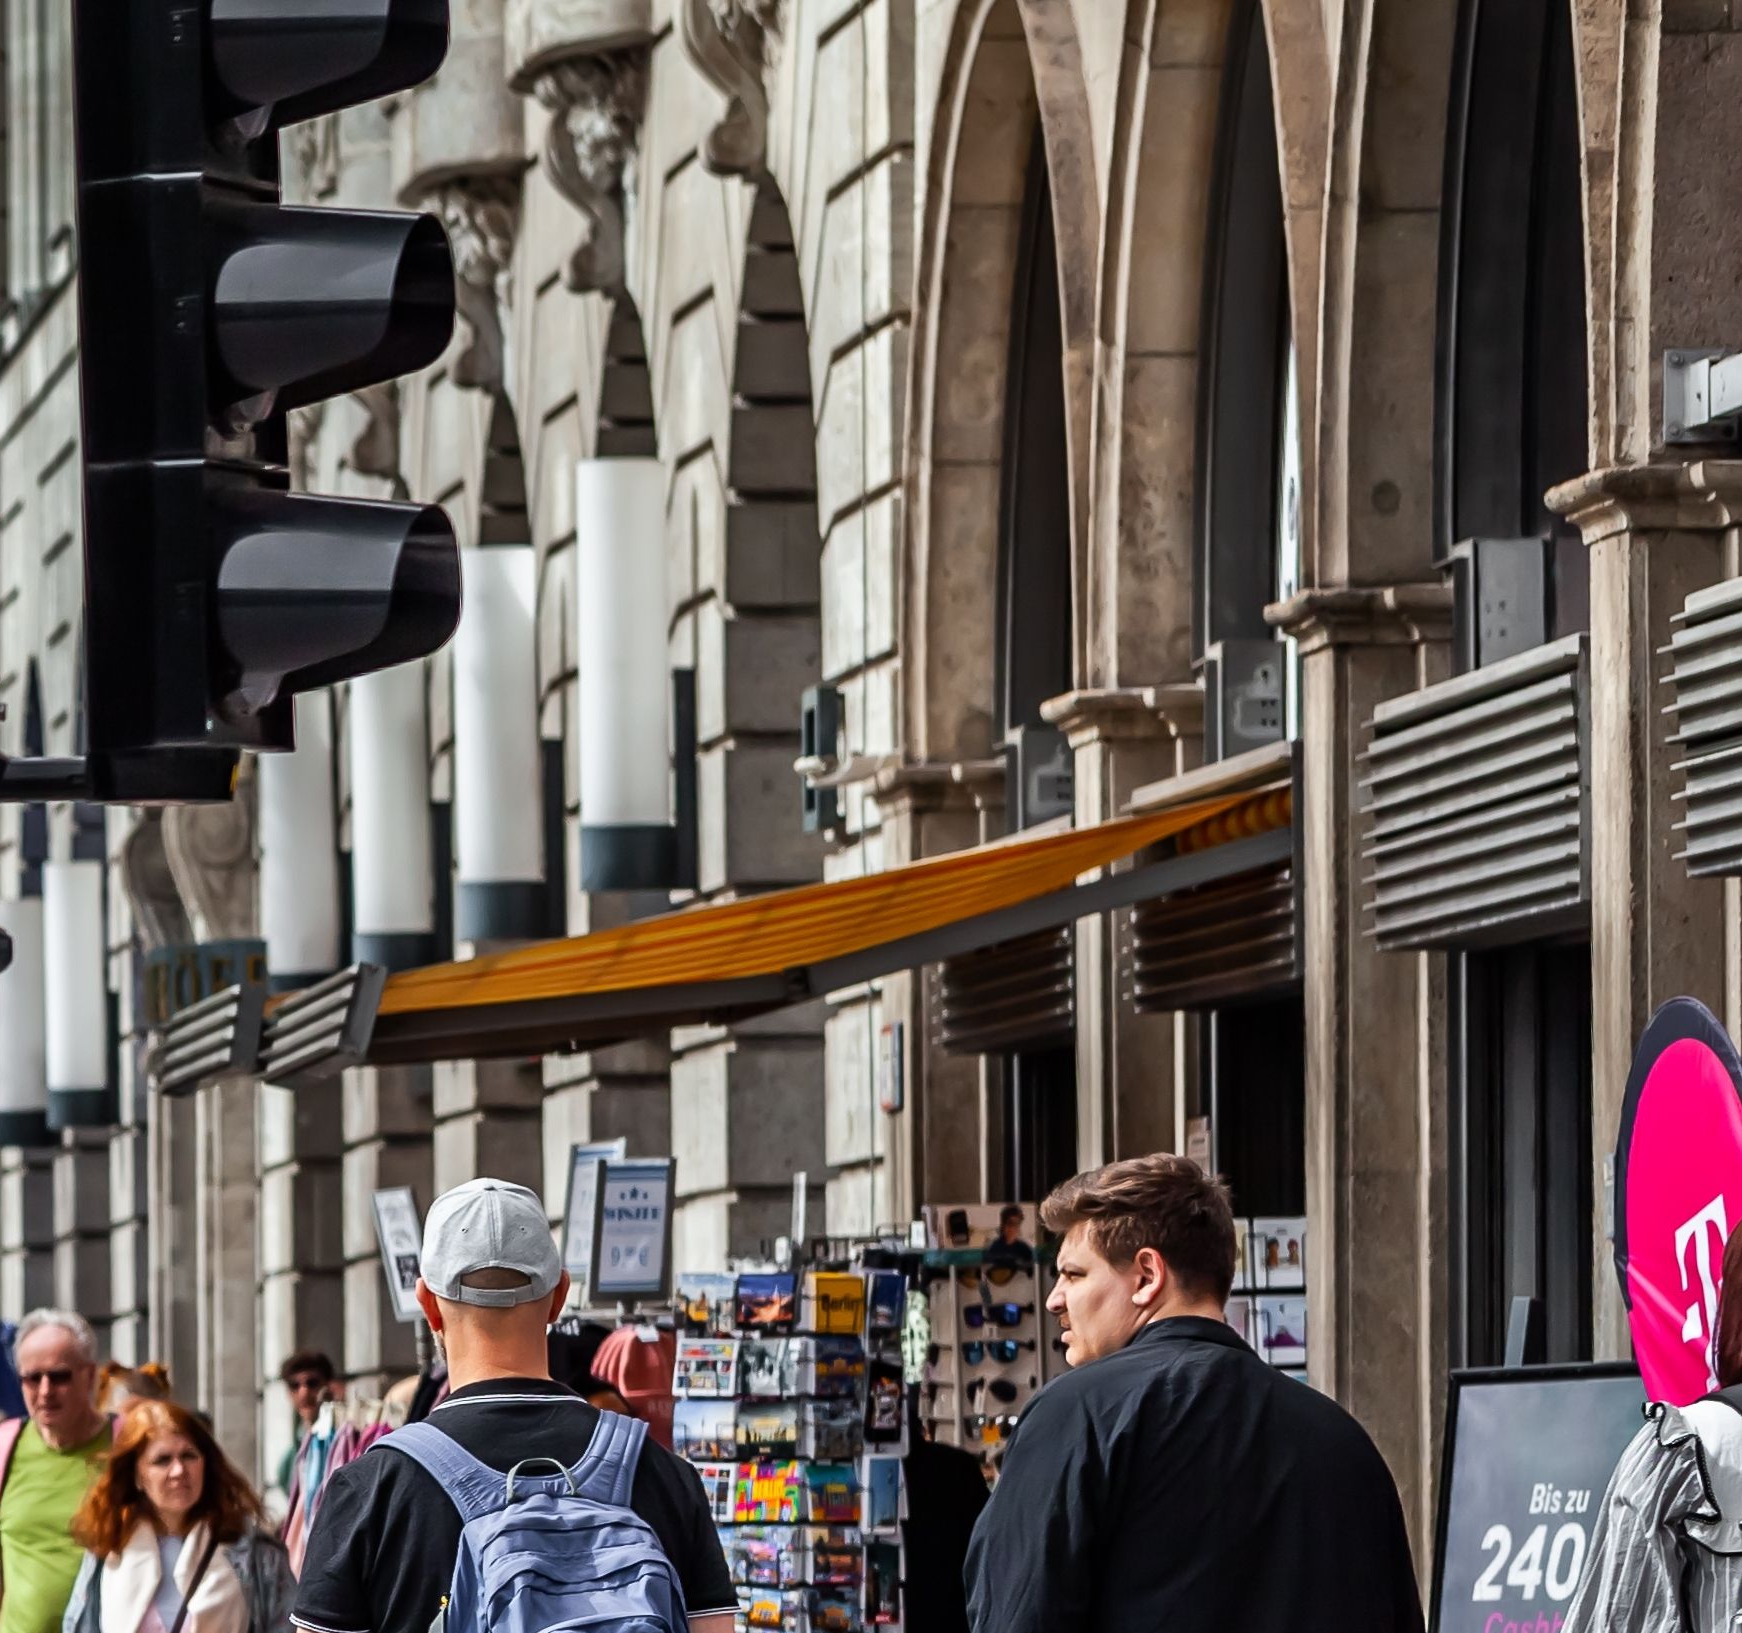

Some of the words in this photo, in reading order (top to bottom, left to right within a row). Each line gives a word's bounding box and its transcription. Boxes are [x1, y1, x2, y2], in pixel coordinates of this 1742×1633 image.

[1529, 1483, 1563, 1514] Bis
[1565, 1489, 1592, 1513] zu
[1472, 1522, 1587, 1602] 240
